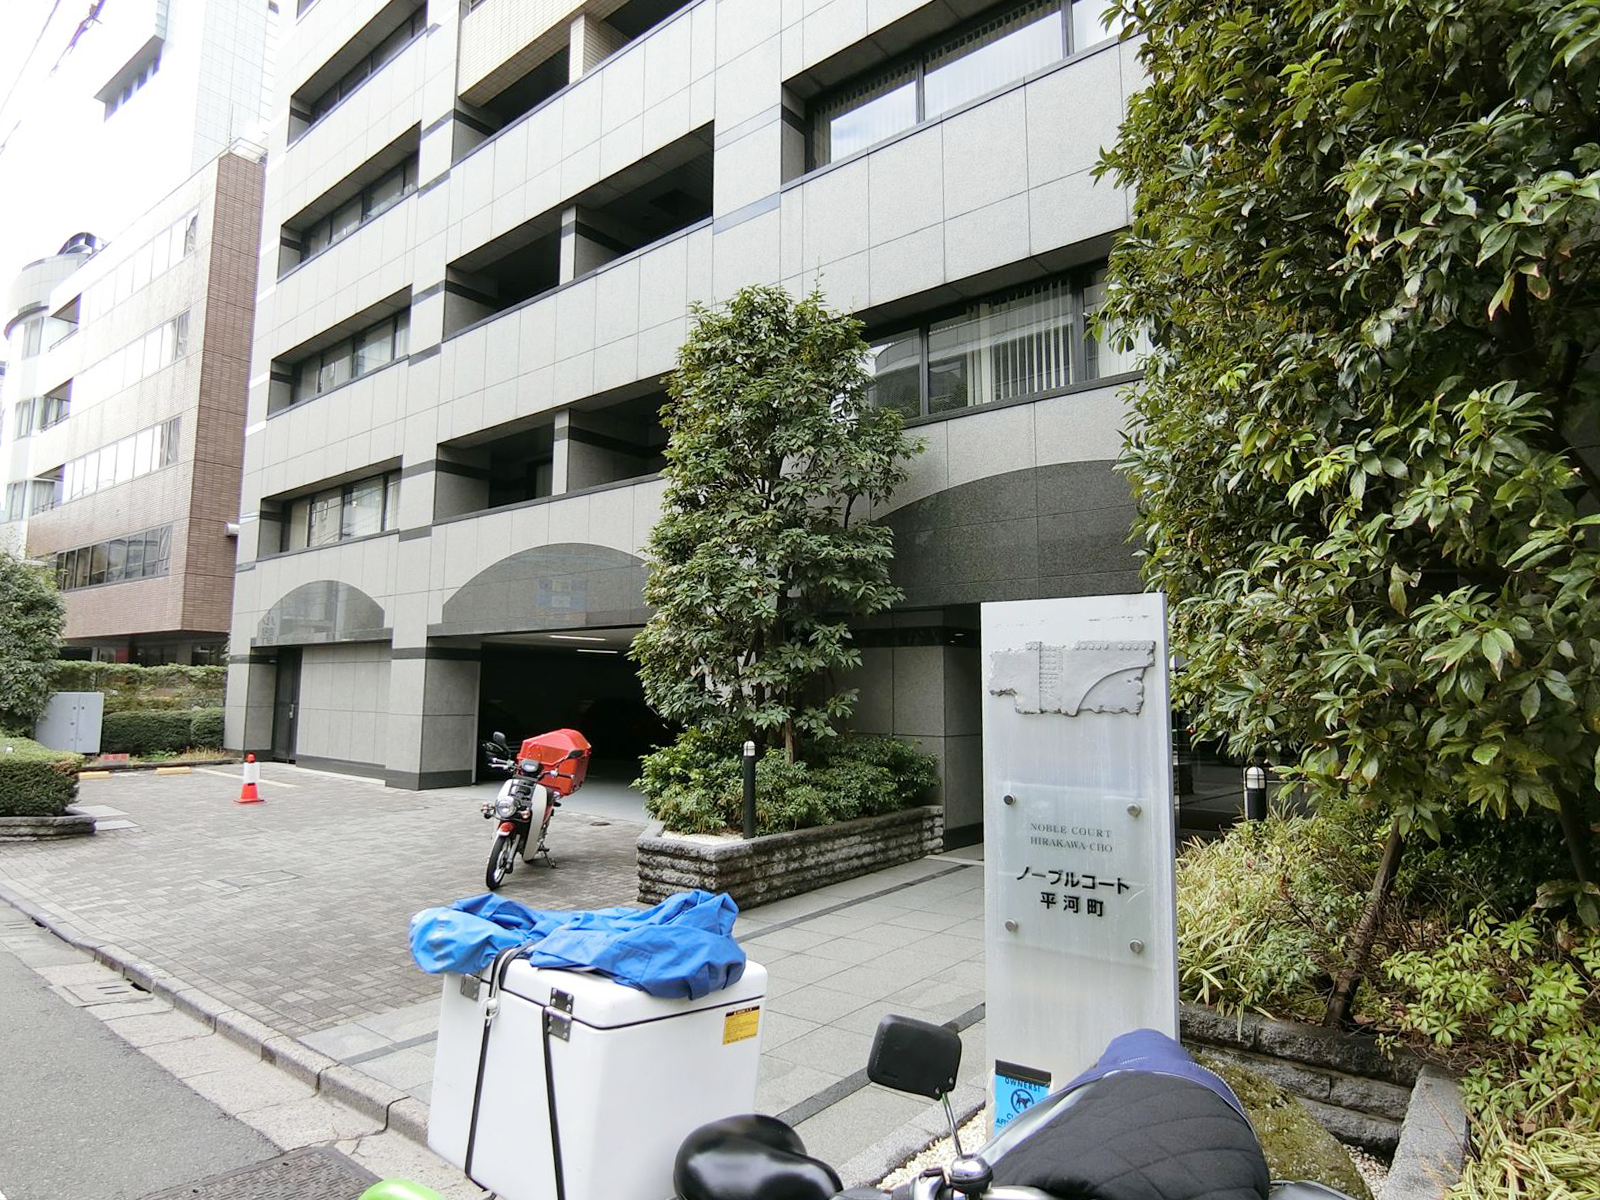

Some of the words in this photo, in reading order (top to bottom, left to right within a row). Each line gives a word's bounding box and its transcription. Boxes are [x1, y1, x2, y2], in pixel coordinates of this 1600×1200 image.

[1031, 823, 1066, 834] NOBLE
[1072, 827, 1112, 838] COURT
[1030, 837, 1113, 852] HIRAKAWA-CHO
[1017, 866, 1130, 894] ノーブルコート
[1040, 891, 1104, 917] 平河町
